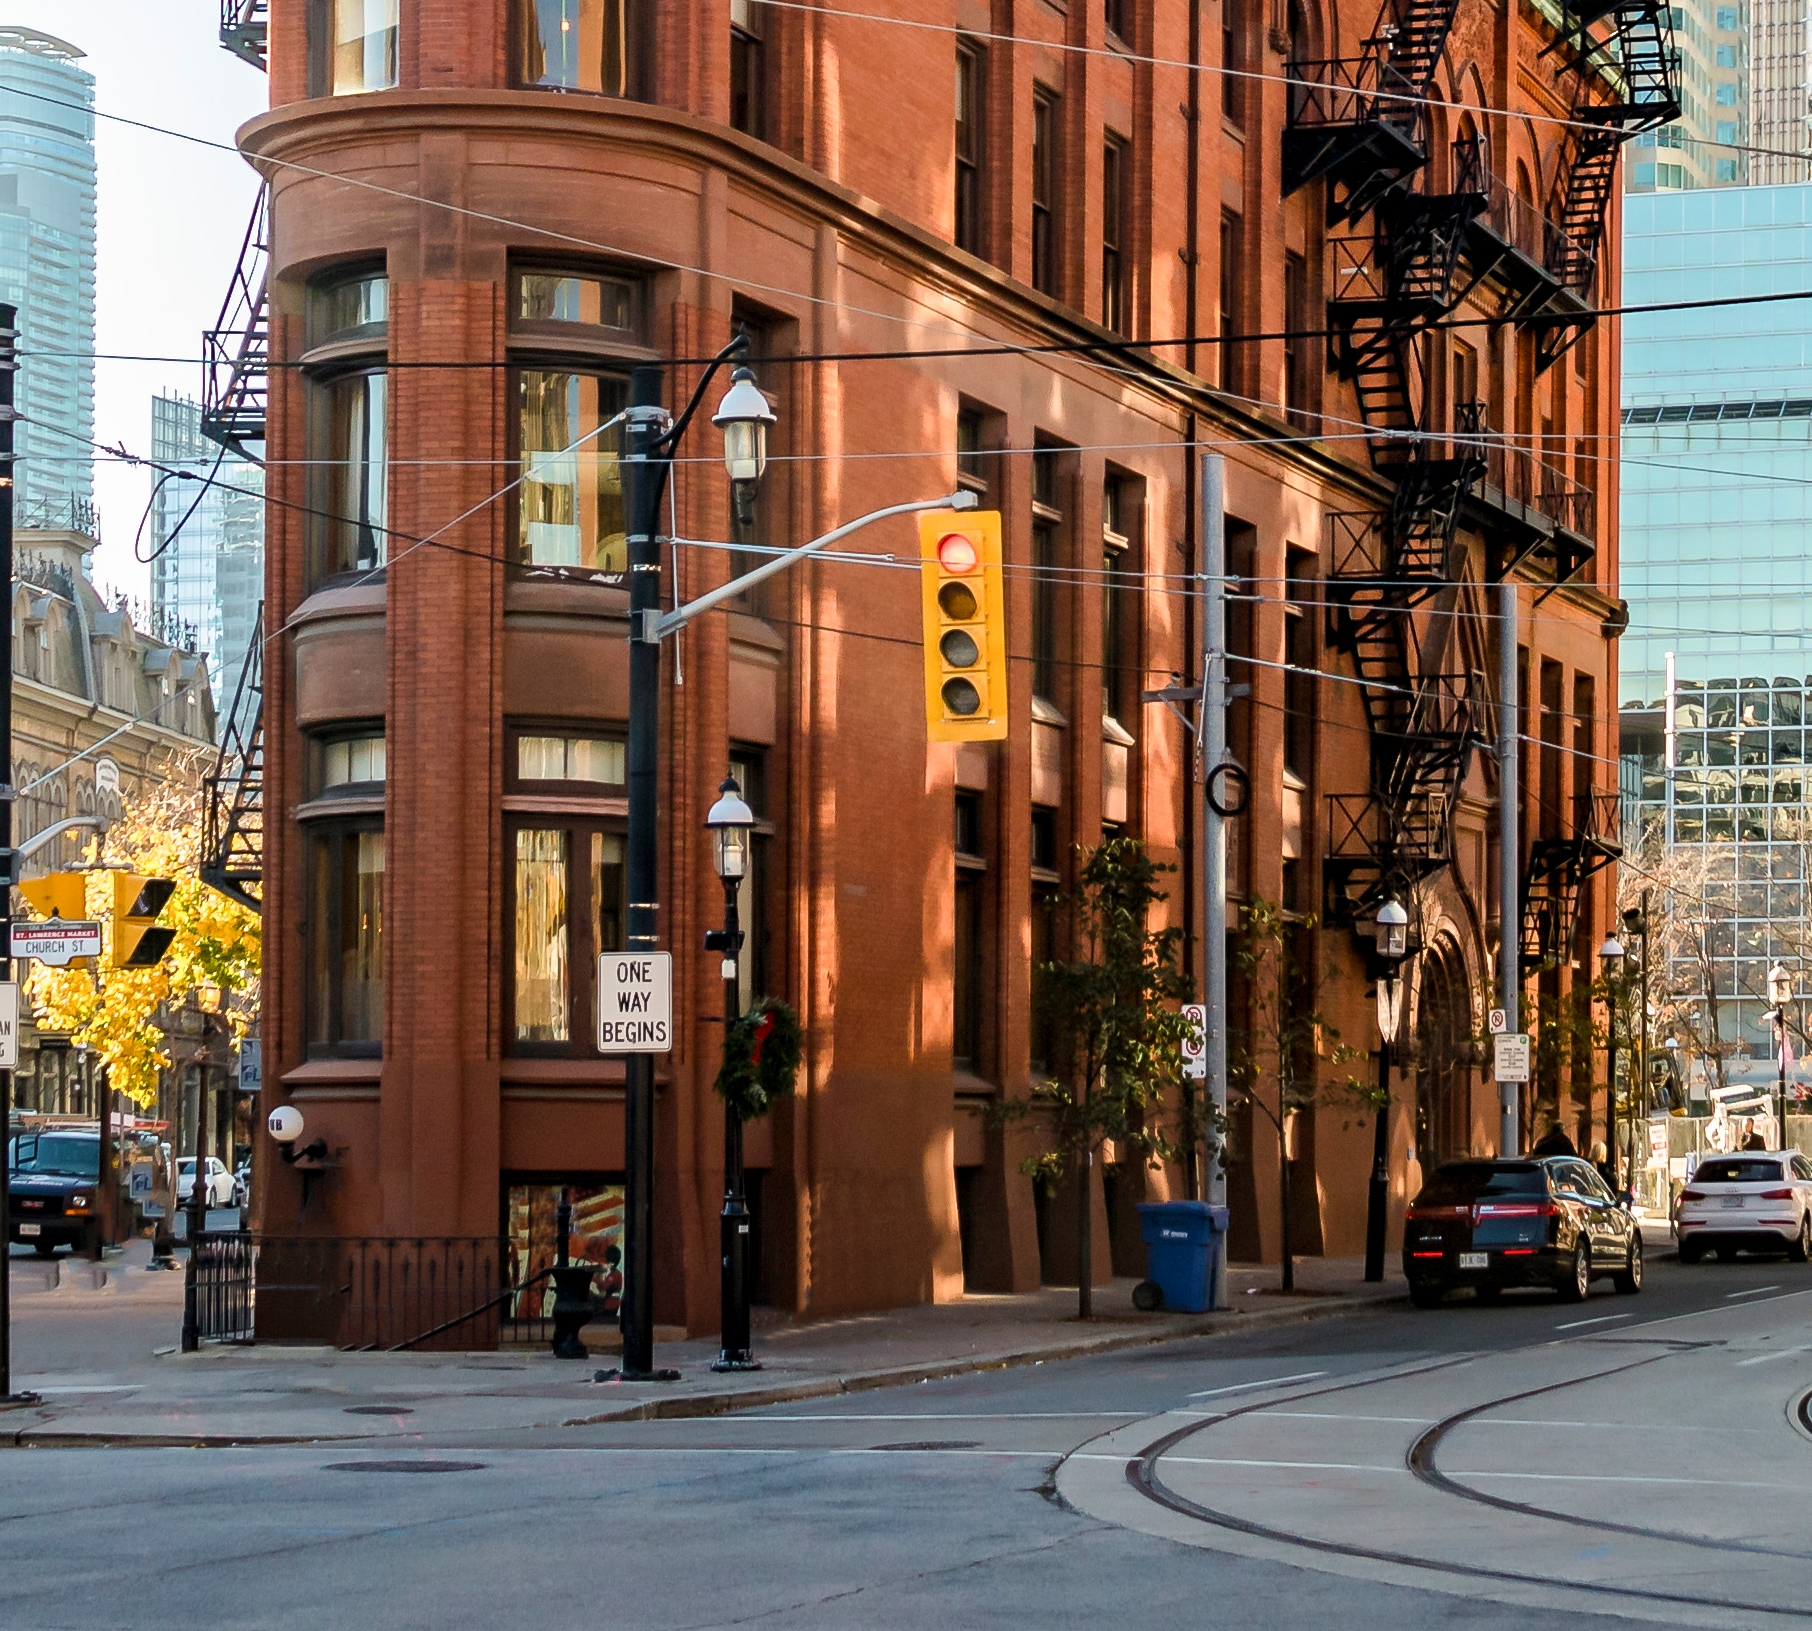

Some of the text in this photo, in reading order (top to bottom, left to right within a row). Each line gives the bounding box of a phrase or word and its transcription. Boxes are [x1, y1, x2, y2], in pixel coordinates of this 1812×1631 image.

[28, 931, 66, 939] LAWRENCE
[25, 940, 65, 954] CHURCH
[616, 961, 653, 983] ONE
[617, 991, 652, 1013] WAY
[602, 1021, 667, 1044] BEGINS
